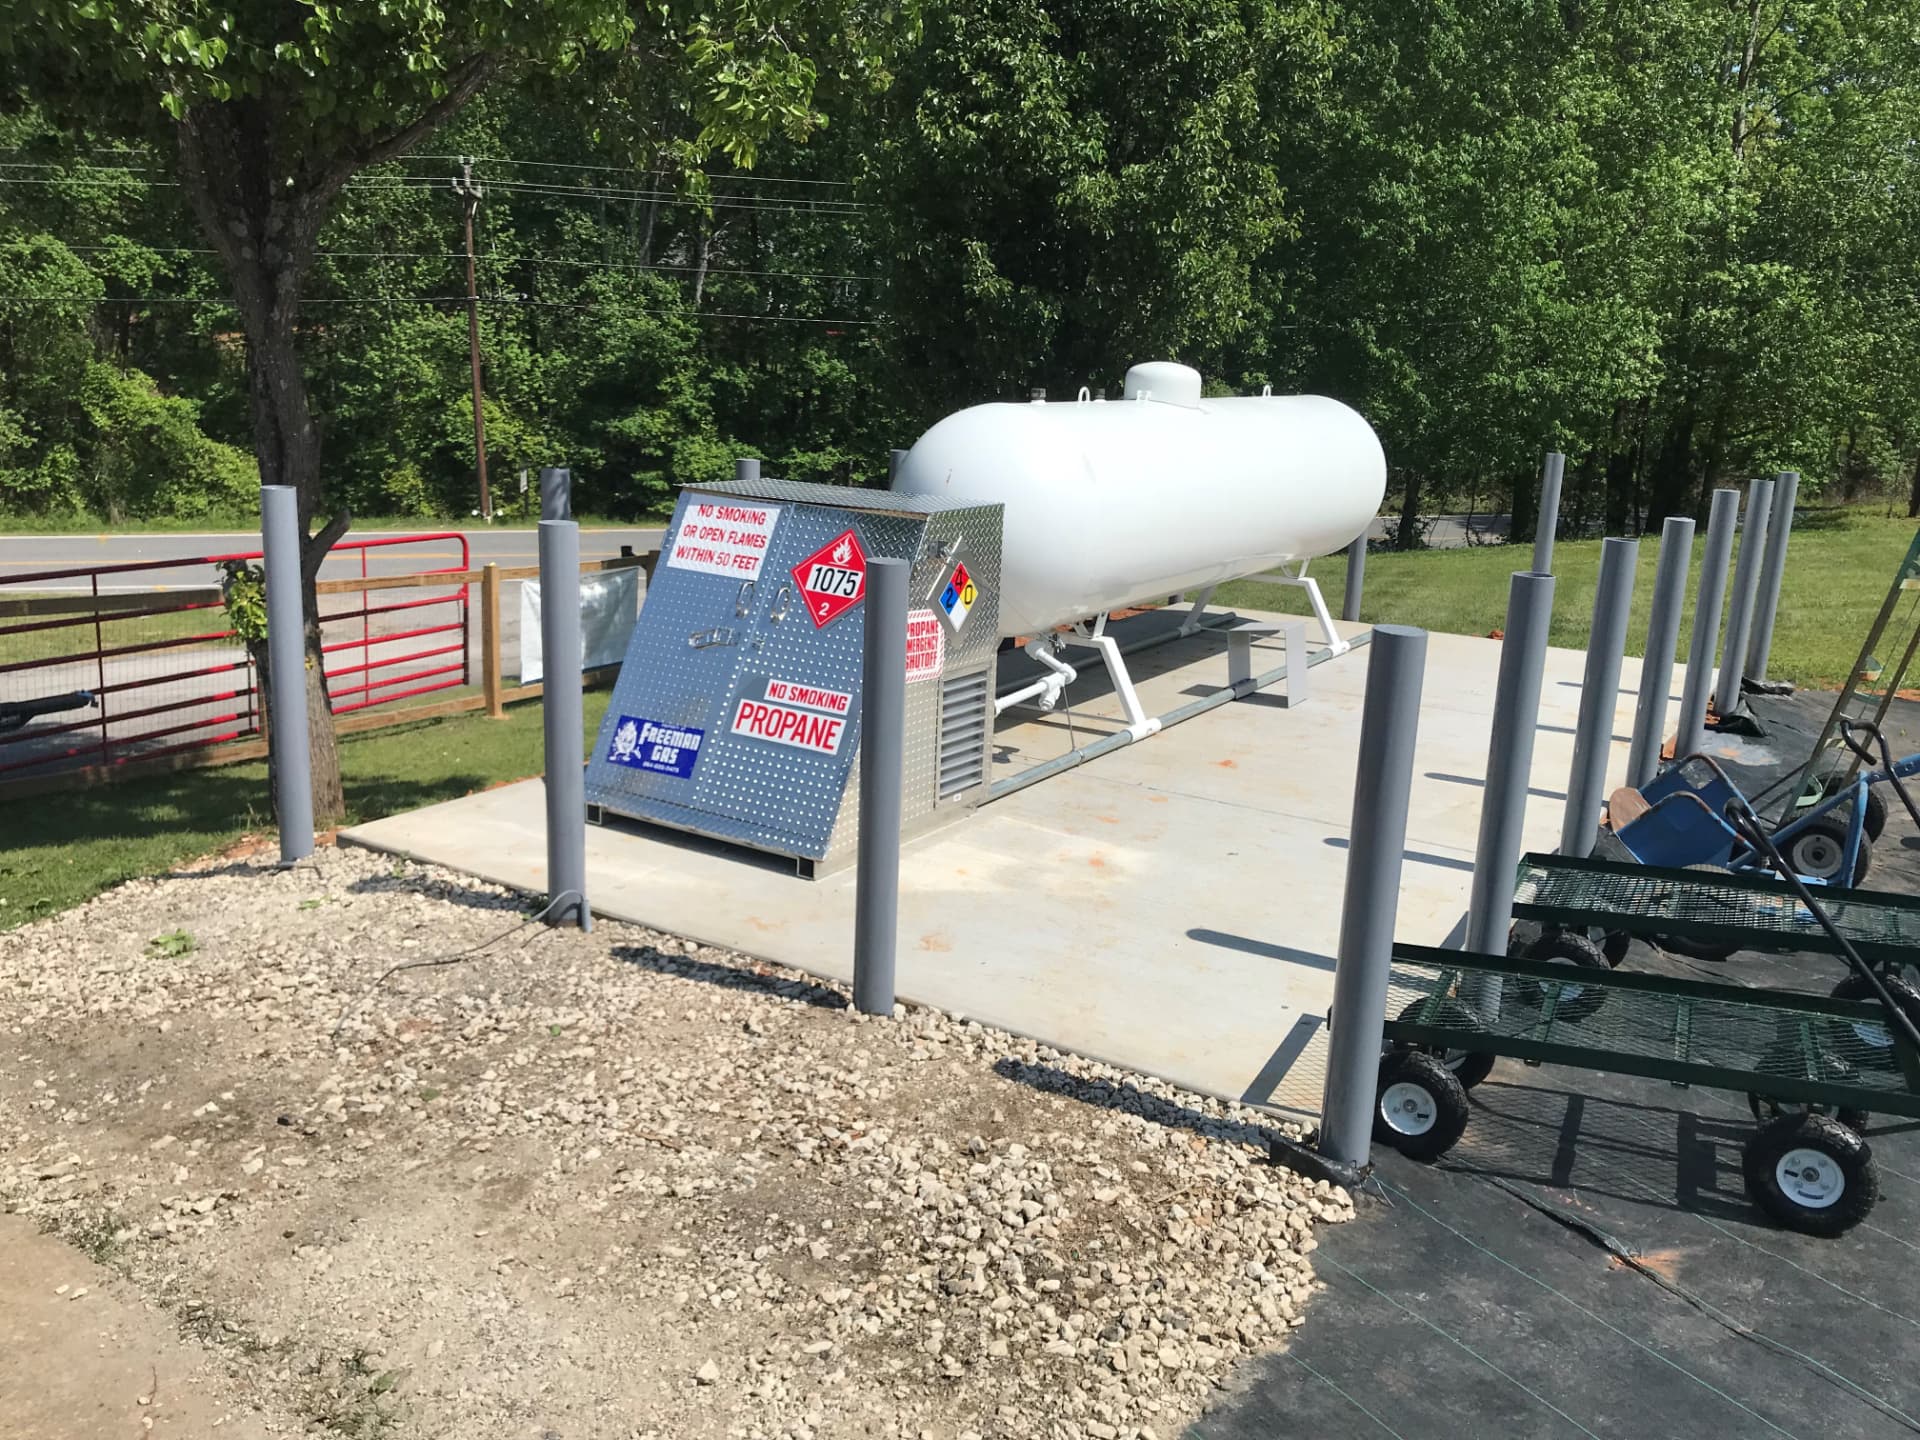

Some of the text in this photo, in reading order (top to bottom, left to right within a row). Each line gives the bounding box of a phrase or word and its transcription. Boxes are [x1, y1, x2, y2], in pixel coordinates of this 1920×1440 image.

[698, 503, 767, 526] NO SMOKING
[683, 524, 767, 549] OR OPEN FLAMES
[676, 545, 760, 571] WITHIN 50 FEET
[812, 566, 859, 596] 1075
[954, 568, 964, 589] 4
[945, 587, 954, 608] 2
[964, 584, 973, 605] 0
[818, 602, 830, 616] 2
[905, 635, 939, 654] MERGENCY
[768, 682, 849, 712] NO SMOKING
[638, 722, 702, 751] FREEMAN
[735, 702, 842, 750] PROPANE
[650, 745, 680, 765] GAS
